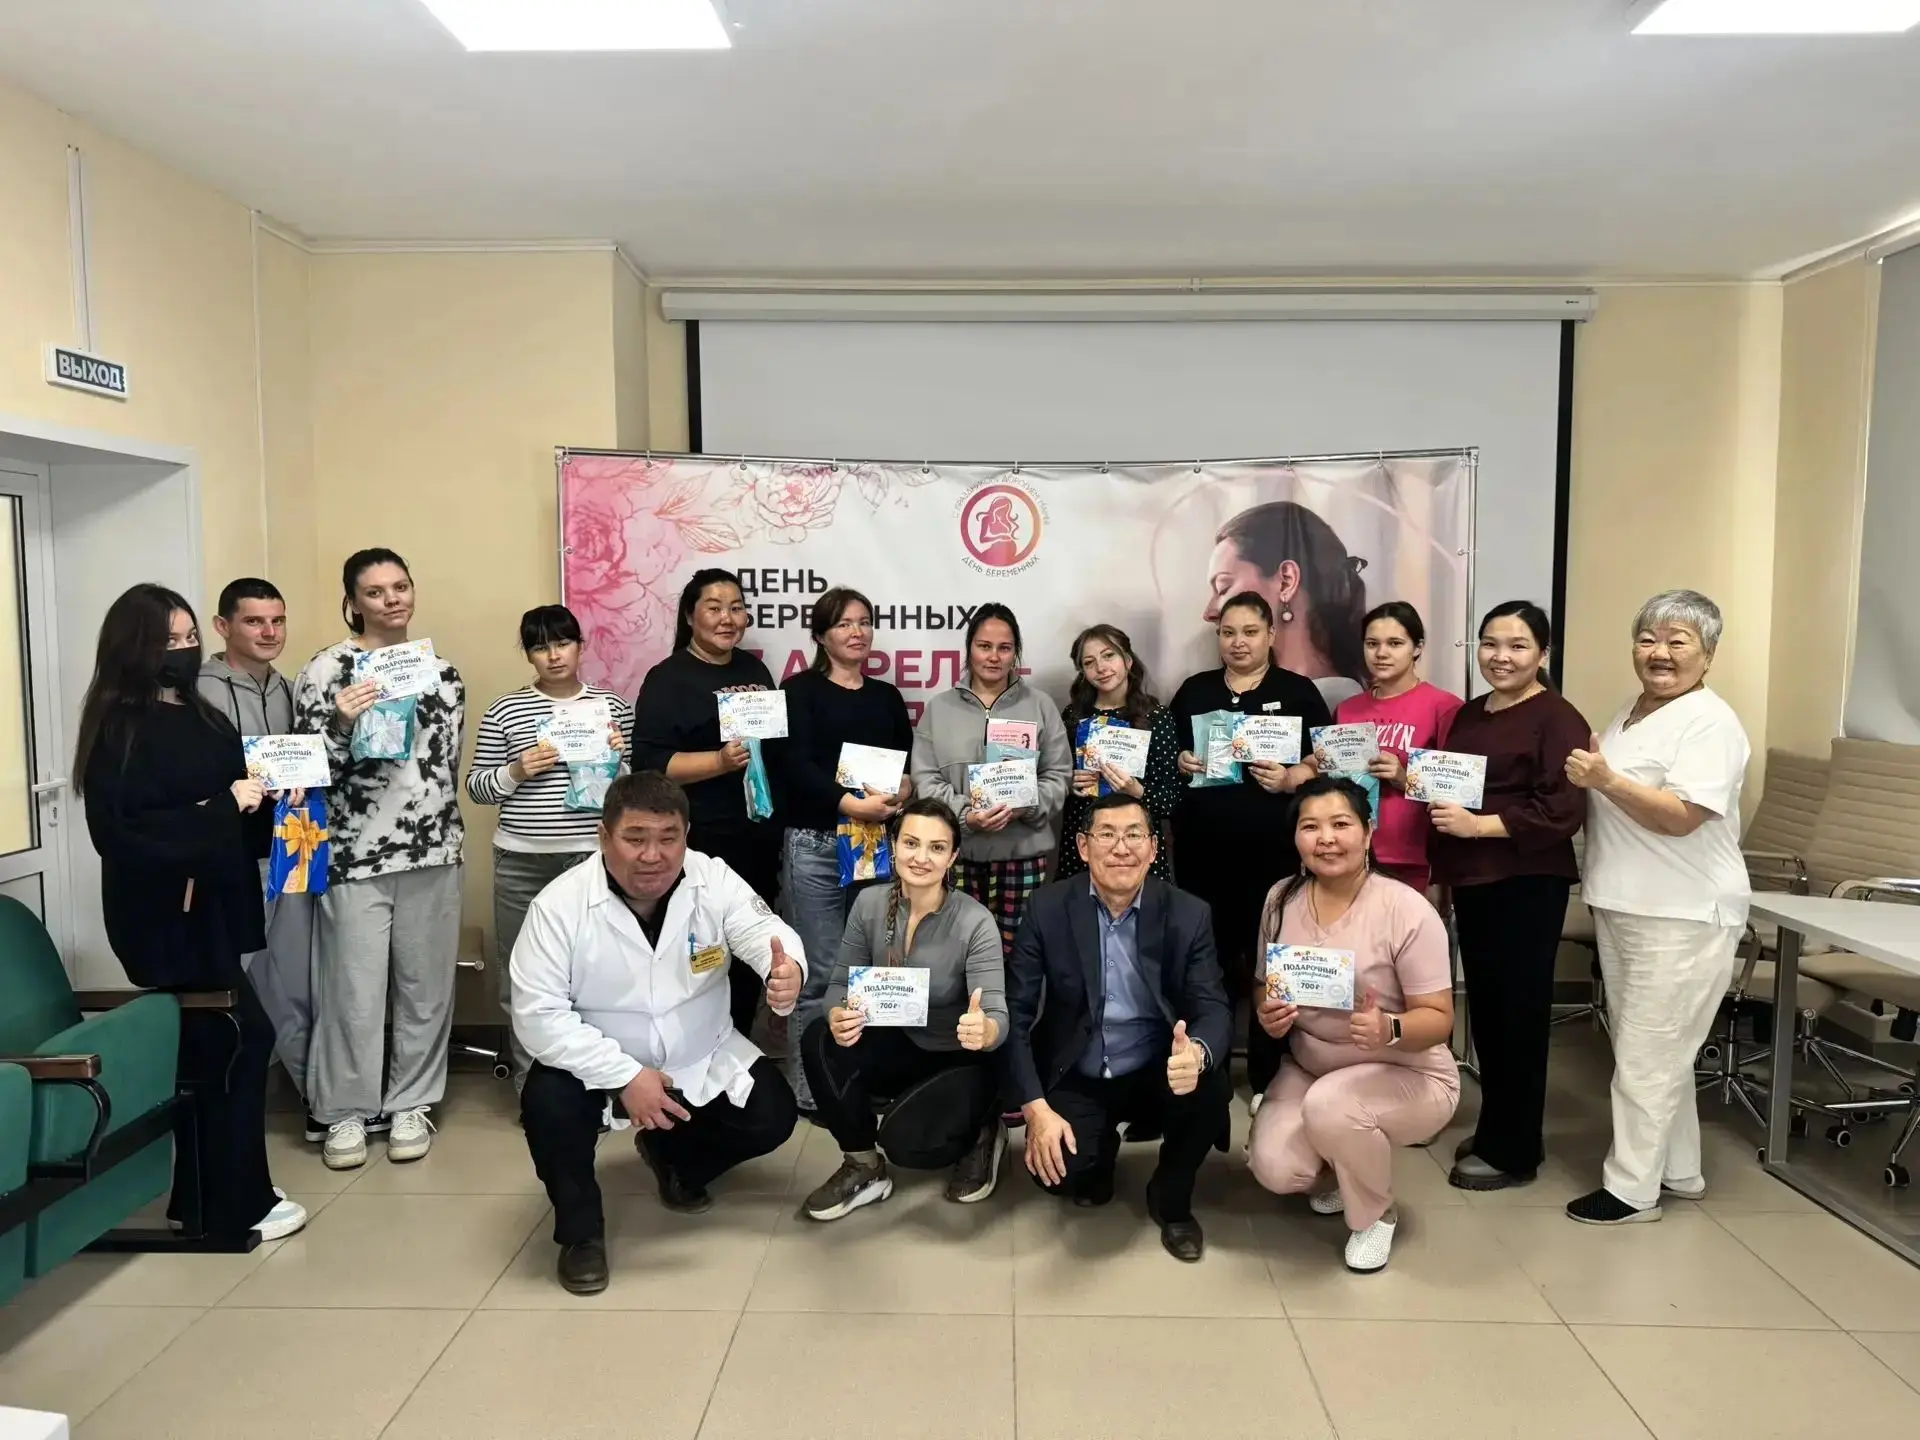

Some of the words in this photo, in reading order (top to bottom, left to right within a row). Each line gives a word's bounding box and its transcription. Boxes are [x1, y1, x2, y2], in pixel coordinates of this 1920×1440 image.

[58, 352, 122, 389] ВЫХОД
[961, 556, 983, 573] ДЕНЬ
[985, 554, 1040, 577] БЕРЕМЕННЫХ
[737, 568, 828, 597] ДЕНЬ
[743, 604, 978, 630] ЕРЕННЫХ
[373, 656, 421, 673] ПОДАРОЧНЫЙ
[781, 649, 961, 689] АРЕЛ
[550, 729, 595, 737] ПОДАРОЧНЫЙ
[1245, 729, 1289, 737] ПОДАРОЧНЫЙ
[1324, 736, 1366, 747] ПОДАРОЧНЫЙ
[261, 749, 312, 759] ПОДАРОЧНЫЙ
[1421, 765, 1470, 778] ПОДАРОЧНЫЙ
[982, 775, 1025, 785] ПОДАРОЧНЫЙ
[1283, 963, 1338, 975] ПОДАРОЧНЫЙ
[864, 985, 914, 993] ПОДАРОЧНЫЙ
